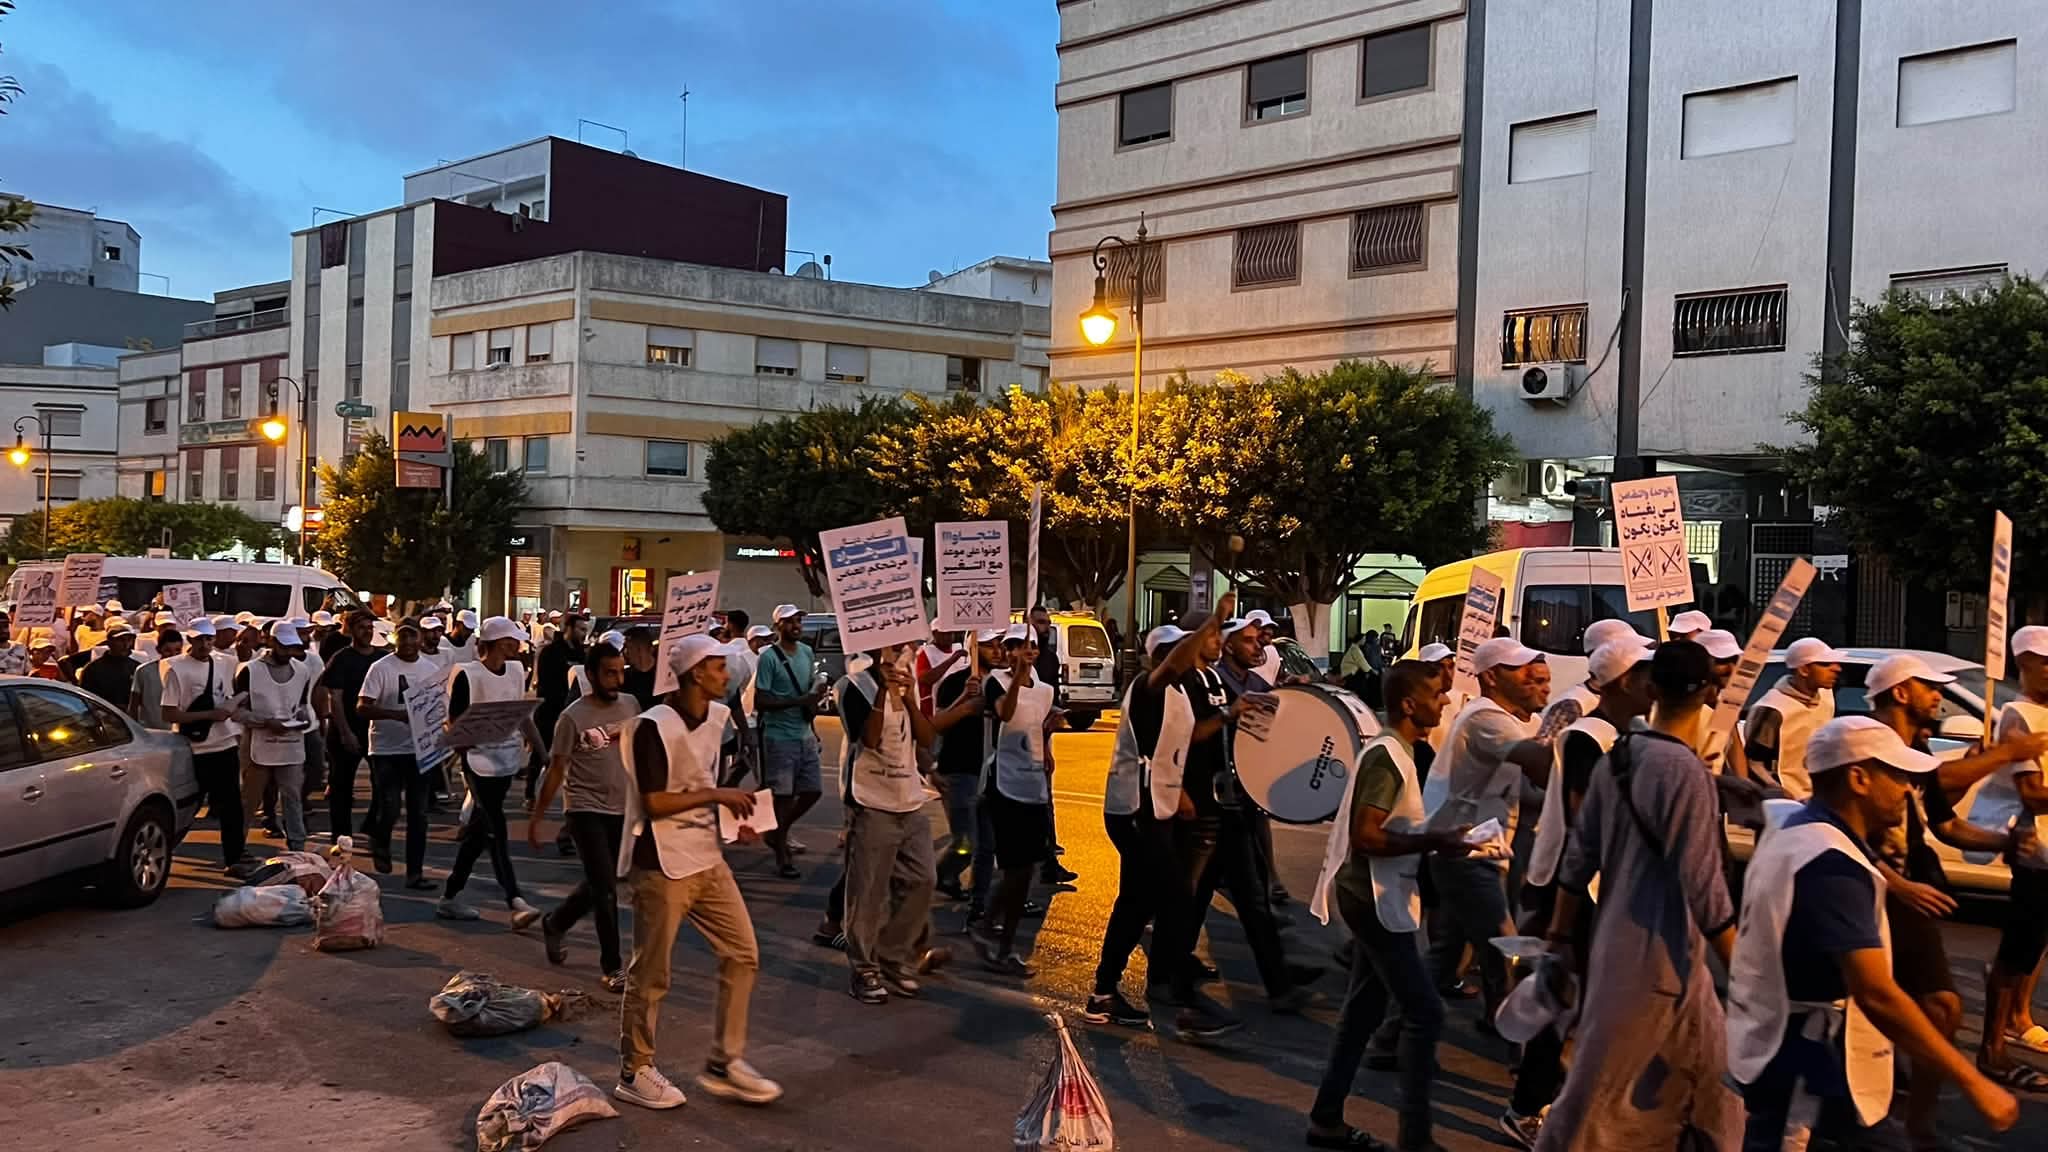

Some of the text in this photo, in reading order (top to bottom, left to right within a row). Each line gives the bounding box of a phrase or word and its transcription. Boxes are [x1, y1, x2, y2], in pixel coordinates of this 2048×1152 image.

[1623, 523, 1651, 539] يكون
[966, 547, 980, 558] على
[981, 545, 1000, 557] كونوا
[987, 560, 1003, 575] مع
